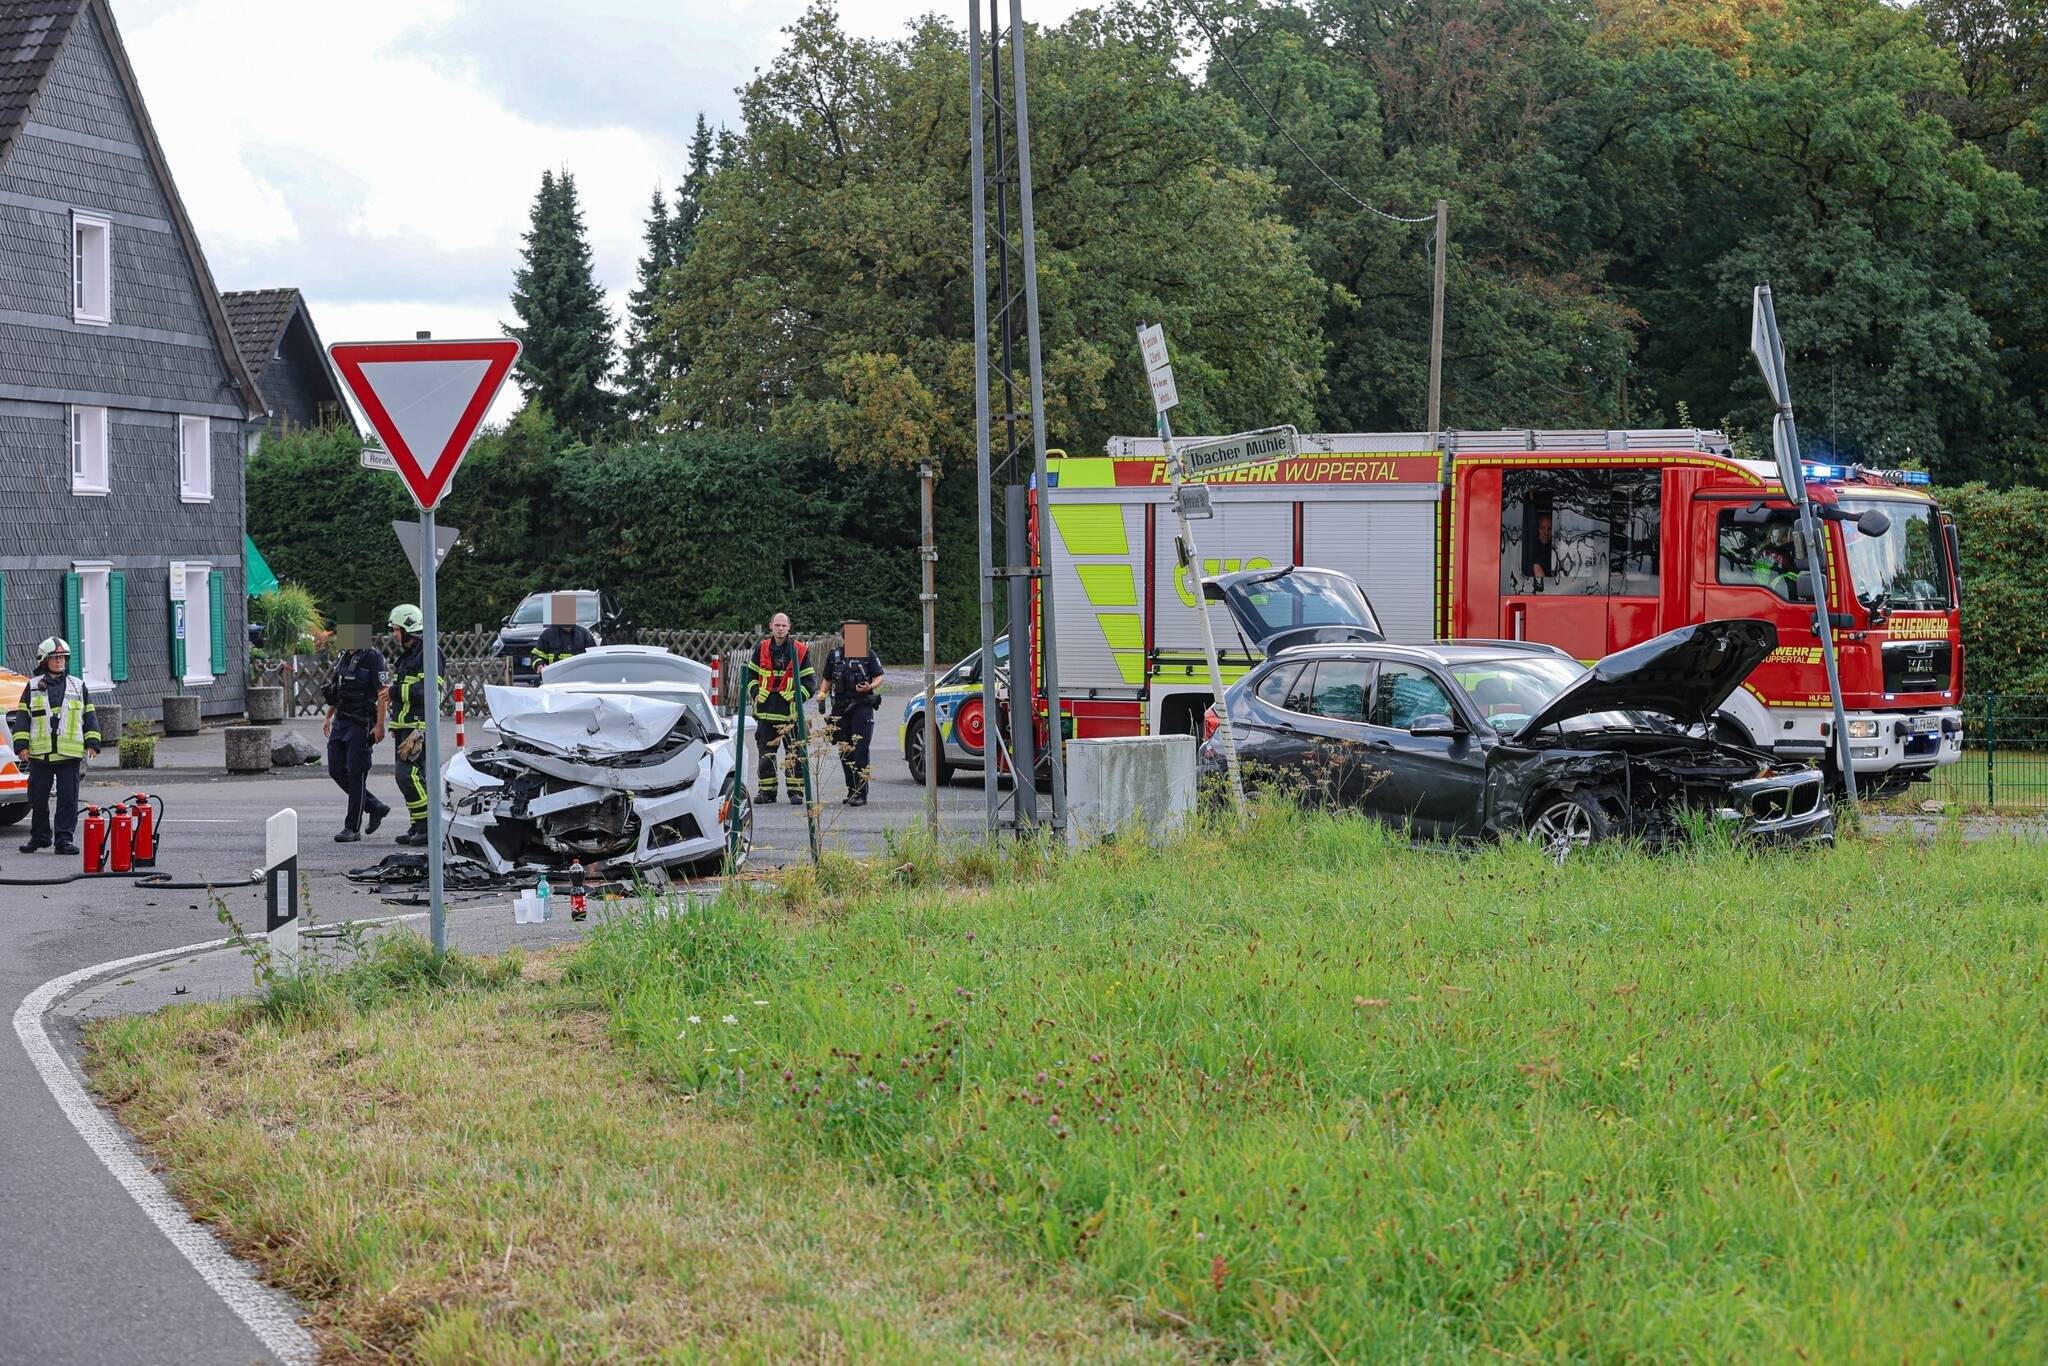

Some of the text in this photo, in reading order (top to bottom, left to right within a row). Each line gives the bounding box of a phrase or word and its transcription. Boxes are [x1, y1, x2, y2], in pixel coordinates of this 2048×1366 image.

[1190, 437, 1286, 467] Ibacher Mühle
[1285, 461, 1399, 481] WUPPERTAL
[1888, 617, 1949, 639] FEUERWEHR
[1762, 656, 1807, 664] UPPERTAL
[1908, 659, 1933, 673] MAN
